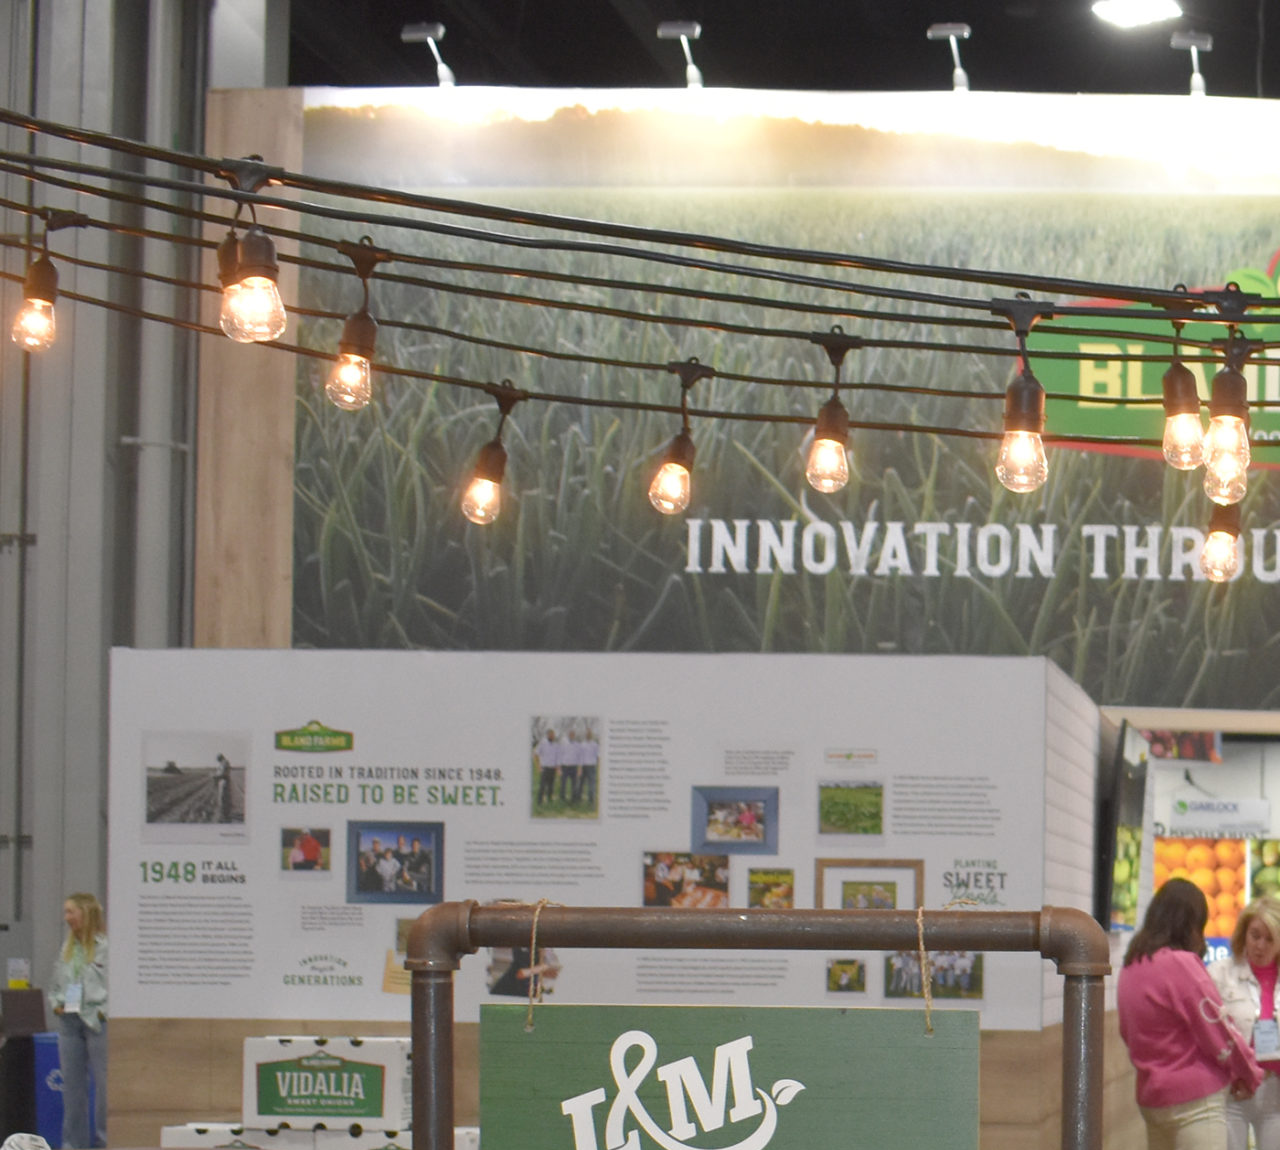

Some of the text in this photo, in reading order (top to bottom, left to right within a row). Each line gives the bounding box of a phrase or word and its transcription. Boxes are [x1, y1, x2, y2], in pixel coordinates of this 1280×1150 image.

[685, 518, 1057, 579] INNOVATION
[274, 765, 505, 781] ROOTED IN TRADITION SINCE 1948.
[273, 783, 505, 806] RAISED TO BE SWEET.
[139, 860, 197, 883] 1948
[202, 860, 238, 872] IT ALL
[201, 873, 247, 884] BEGINS
[943, 871, 1008, 890] SWEET
[283, 974, 364, 987] GENERATIONS
[276, 1071, 366, 1099] VIDALIA
